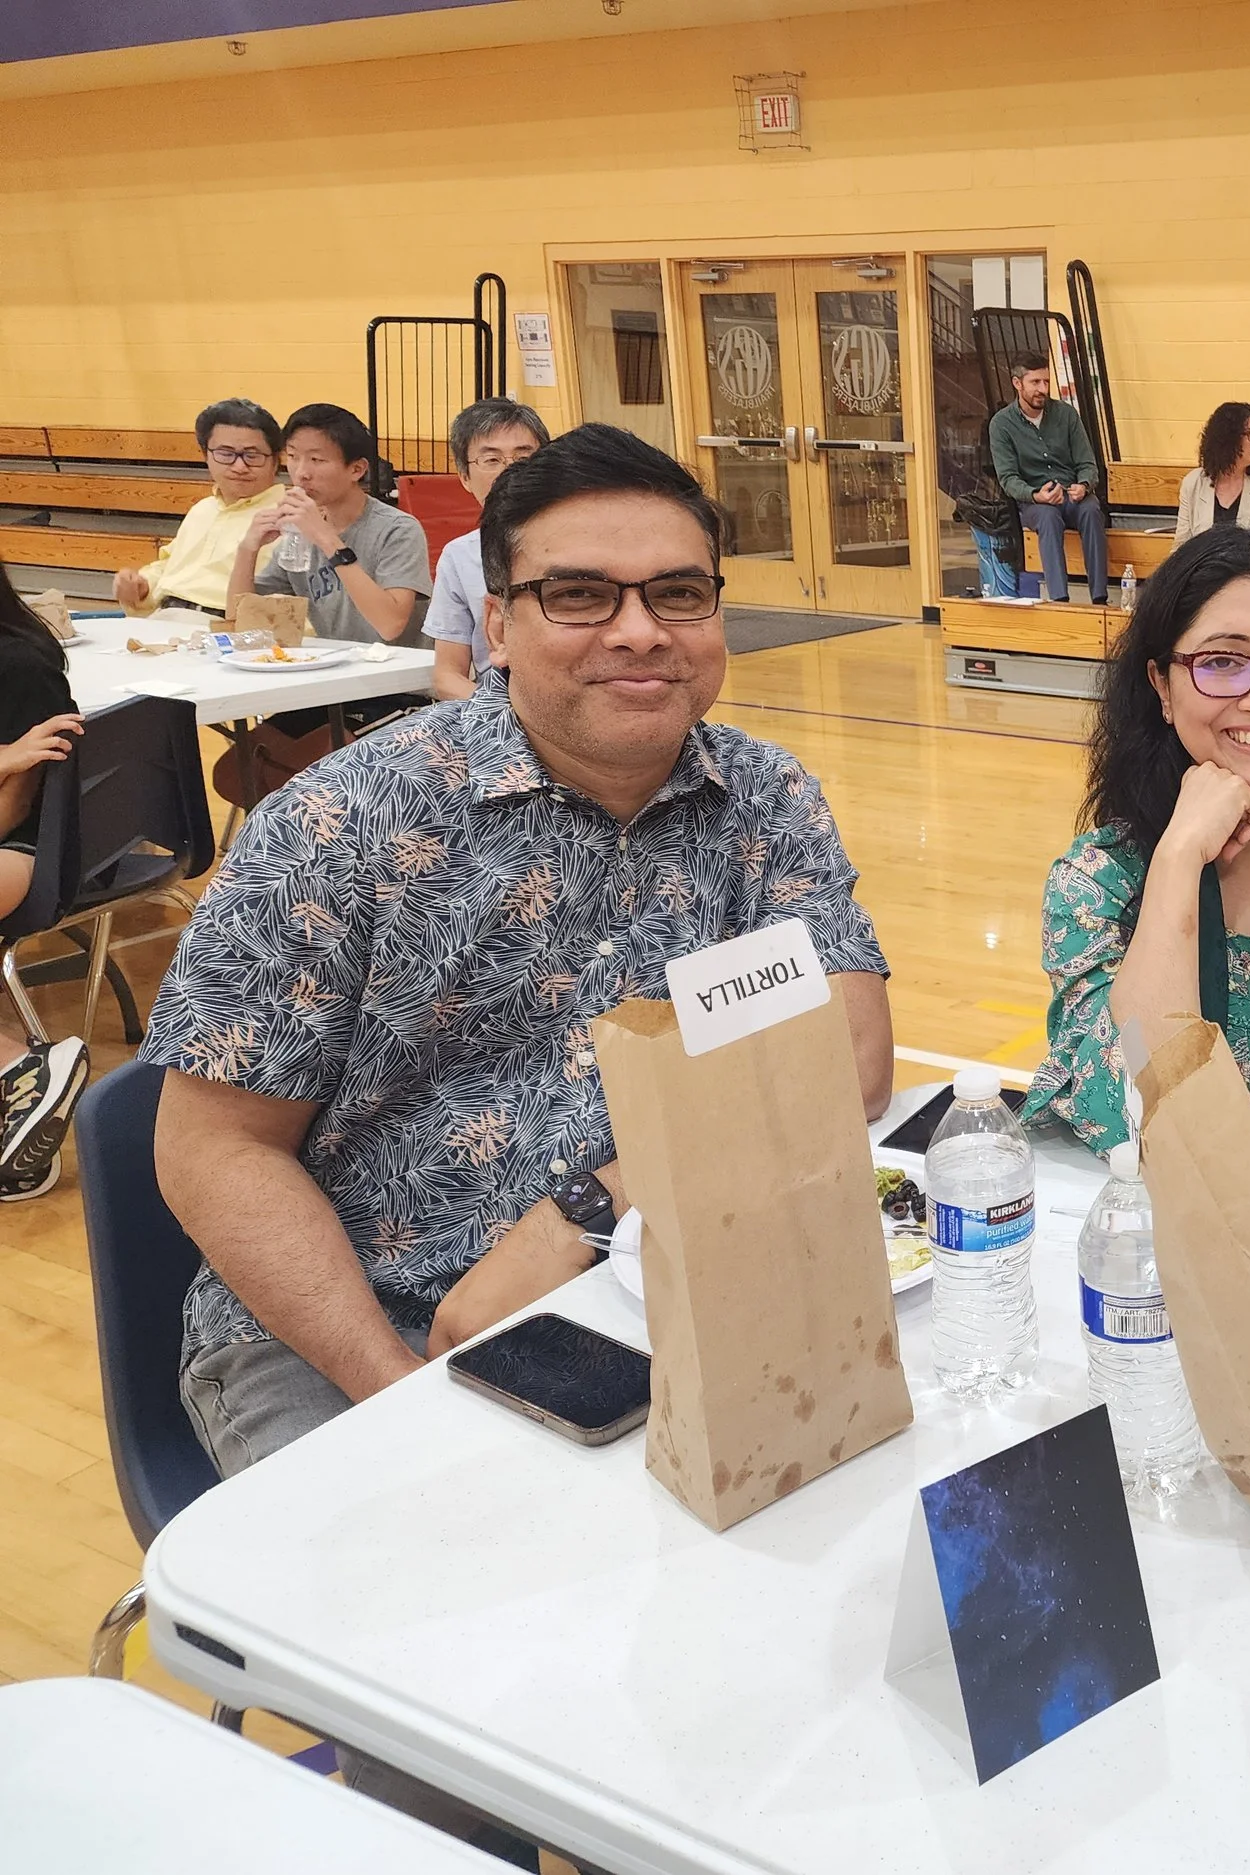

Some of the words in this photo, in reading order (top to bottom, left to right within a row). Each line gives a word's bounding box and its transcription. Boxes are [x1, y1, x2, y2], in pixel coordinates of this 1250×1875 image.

[761, 97, 788, 128] EXIT
[696, 957, 805, 1013] TORTILLA
[986, 1221, 1018, 1239] purified
